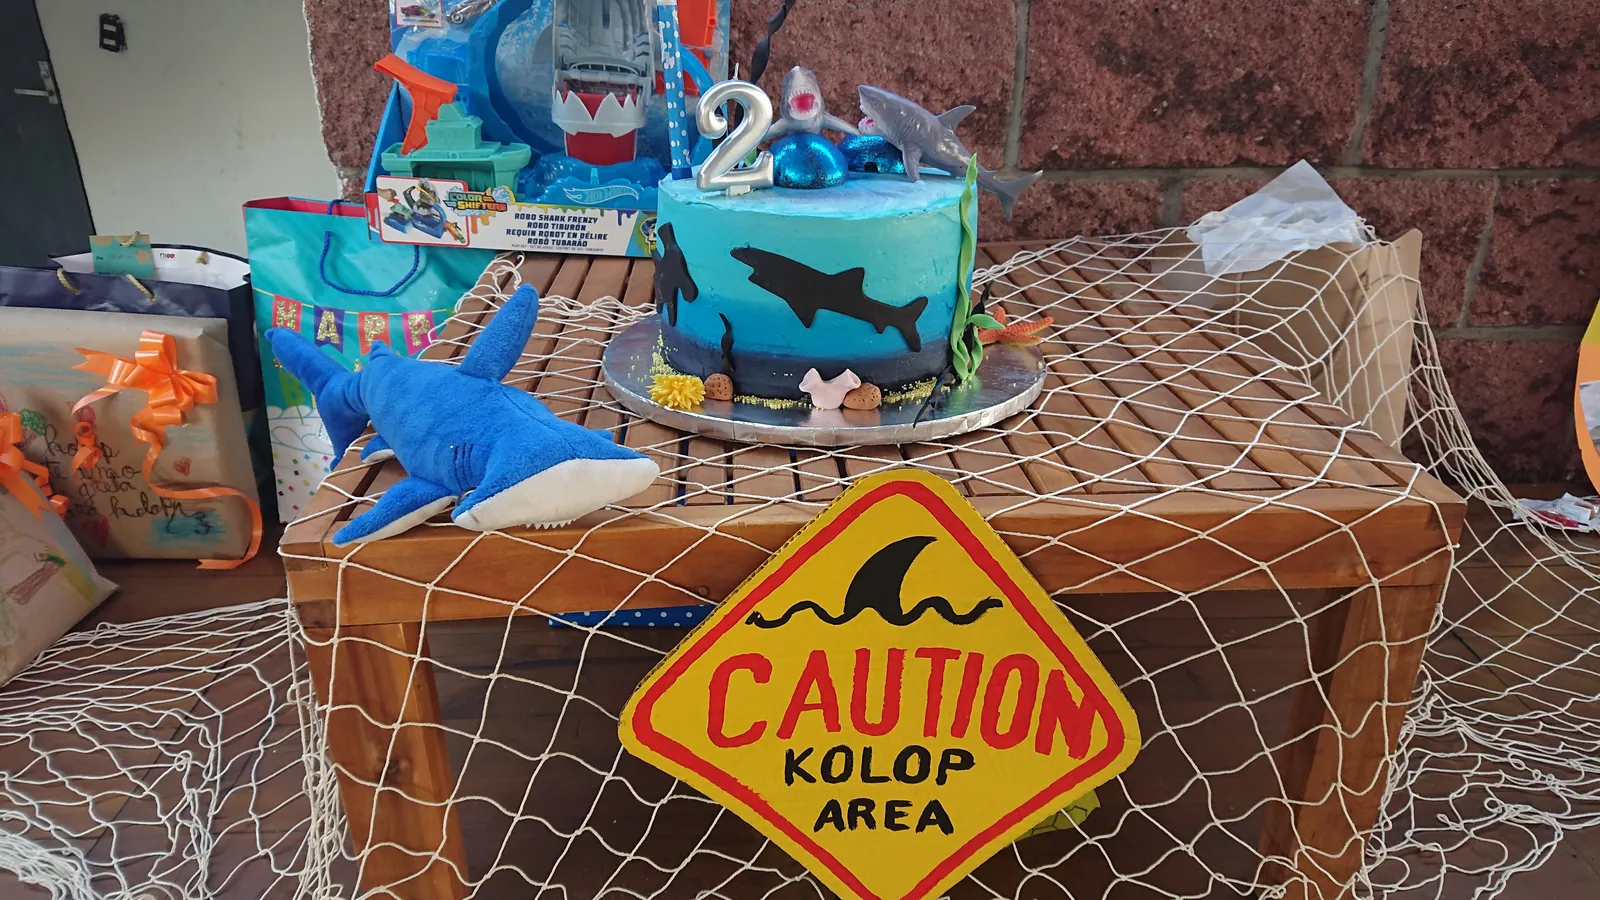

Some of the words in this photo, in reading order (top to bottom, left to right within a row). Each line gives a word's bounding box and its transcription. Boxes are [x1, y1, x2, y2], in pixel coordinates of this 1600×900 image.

[696, 80, 774, 192] 2
[449, 192, 483, 203] COLOR
[457, 200, 507, 212] SHIFTERS
[514, 213, 536, 221] ROBO
[538, 214, 565, 222] SHARK
[567, 216, 598, 224] FRENZY
[551, 222, 586, 231] TIBURÓN
[506, 228, 536, 237] REQUIN
[538, 230, 565, 238] ROBOT
[579, 231, 608, 240] DÉLIRE
[707, 647, 1098, 760] CAUTION
[784, 744, 976, 786] KOLOP
[813, 797, 954, 836] AREA
